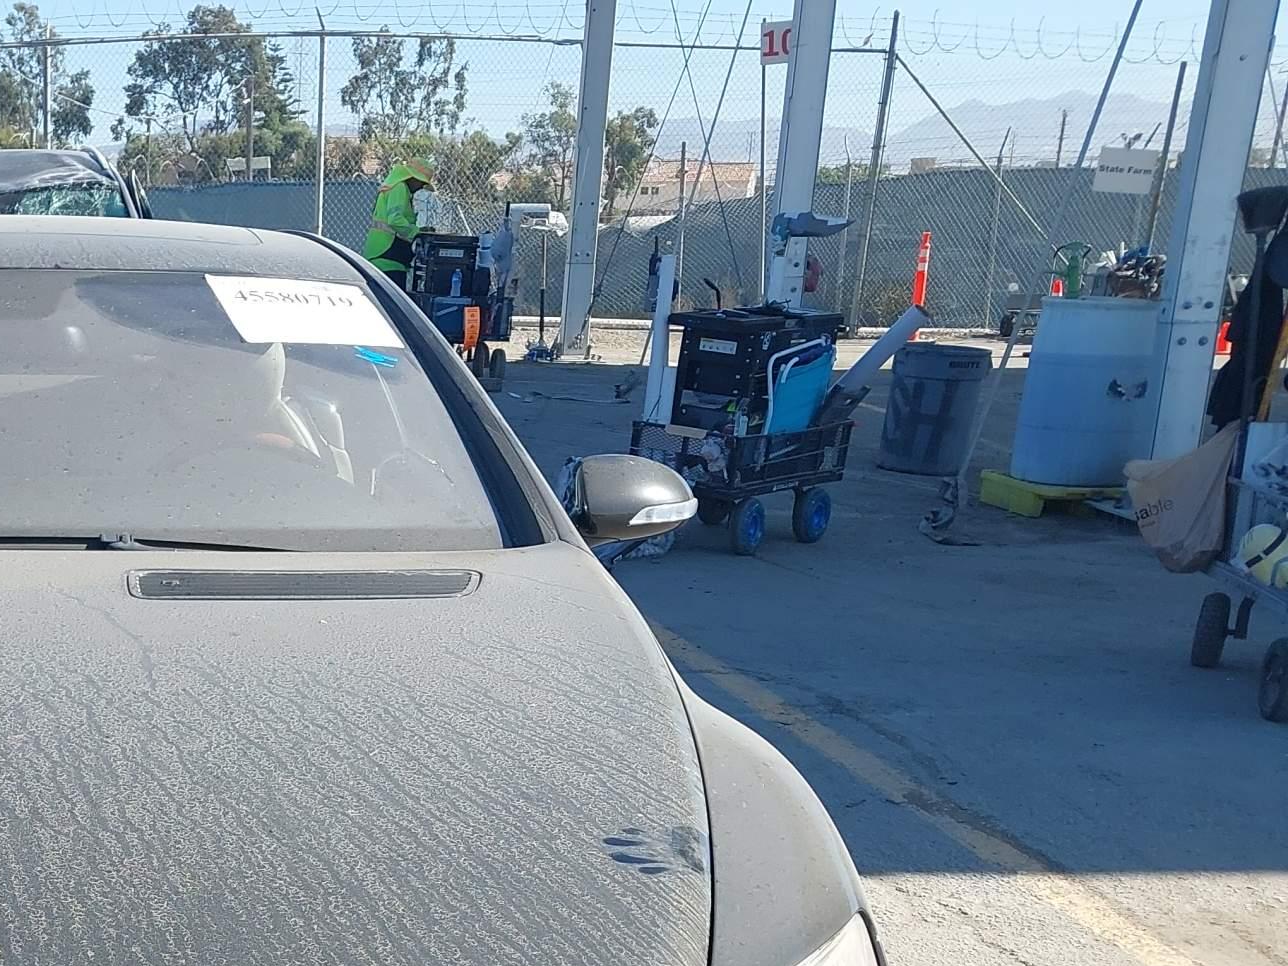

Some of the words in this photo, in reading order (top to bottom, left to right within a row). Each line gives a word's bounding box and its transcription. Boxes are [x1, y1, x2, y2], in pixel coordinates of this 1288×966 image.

[1098, 164, 1125, 174] State
[1127, 165, 1153, 175] Farm
[233, 289, 354, 308] 45580719
